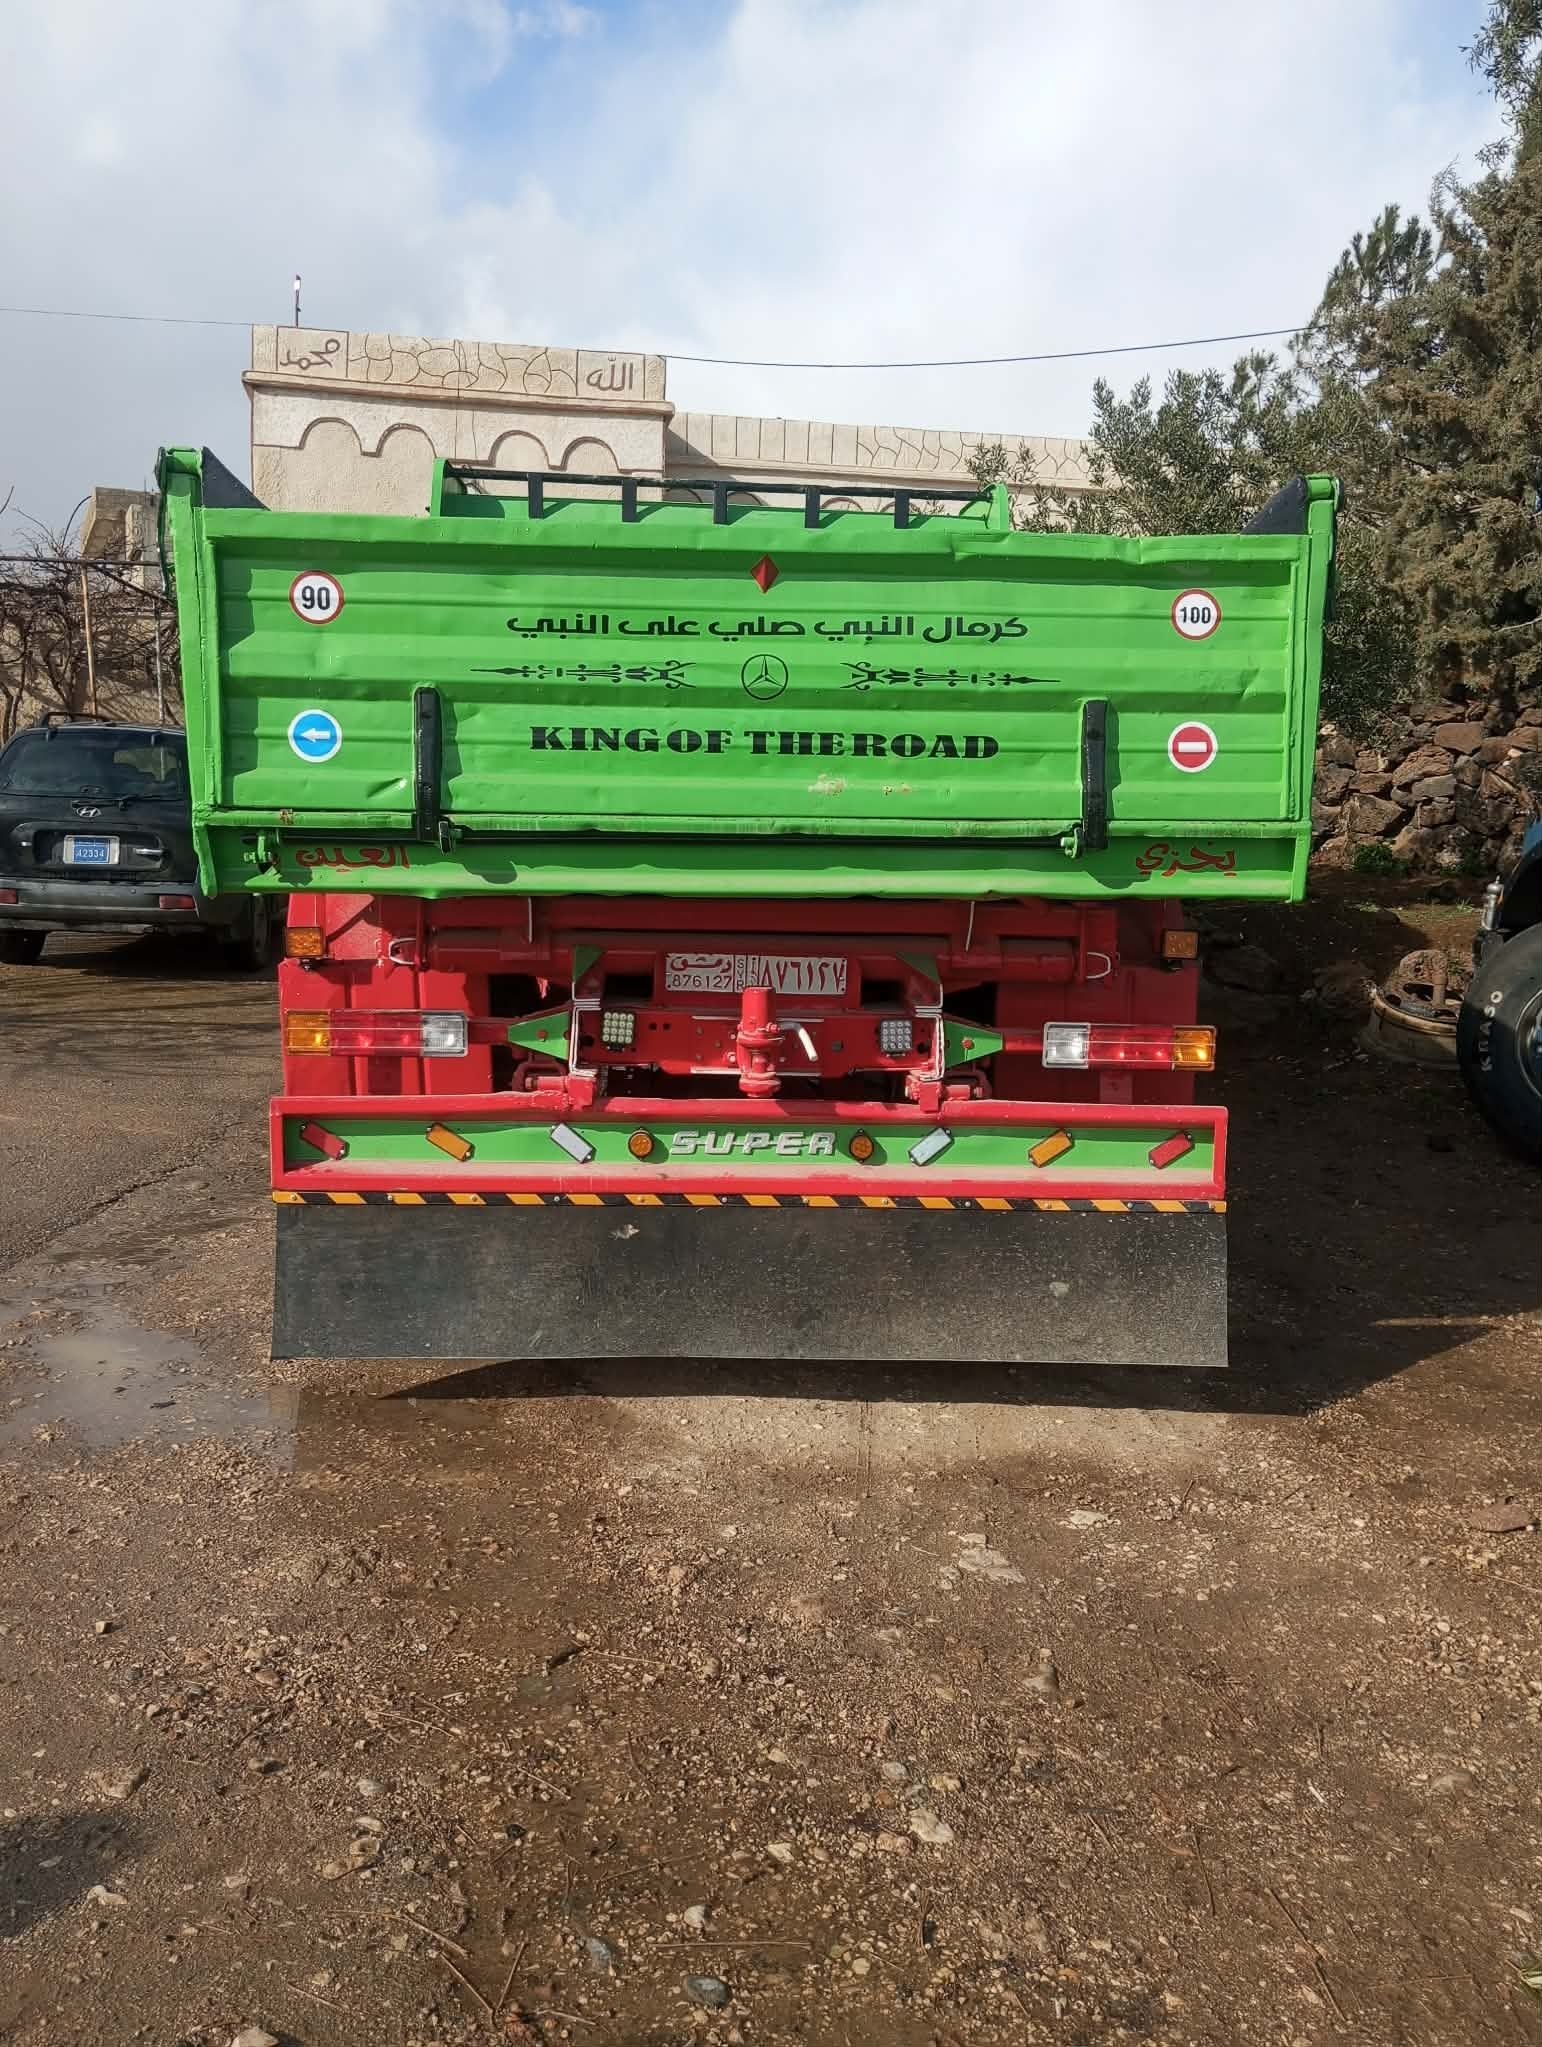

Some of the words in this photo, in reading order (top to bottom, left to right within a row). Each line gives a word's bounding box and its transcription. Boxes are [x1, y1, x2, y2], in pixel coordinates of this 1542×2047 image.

[279, 338, 340, 371] محمد
[586, 356, 634, 392] الله
[301, 585, 331, 611] 90
[507, 612, 610, 639] النبي
[617, 615, 701, 636] على
[708, 615, 806, 642] صلي
[814, 615, 914, 642] النبي
[1180, 606, 1212, 624] 100
[922, 616, 1029, 643] كرمال
[670, 956, 731, 974] دمشق
[736, 958, 746, 991] SYR
[761, 959, 845, 992] ٨٧٦١٢٧
[672, 974, 733, 989] 876127
[670, 1129, 837, 1155] SUPER
